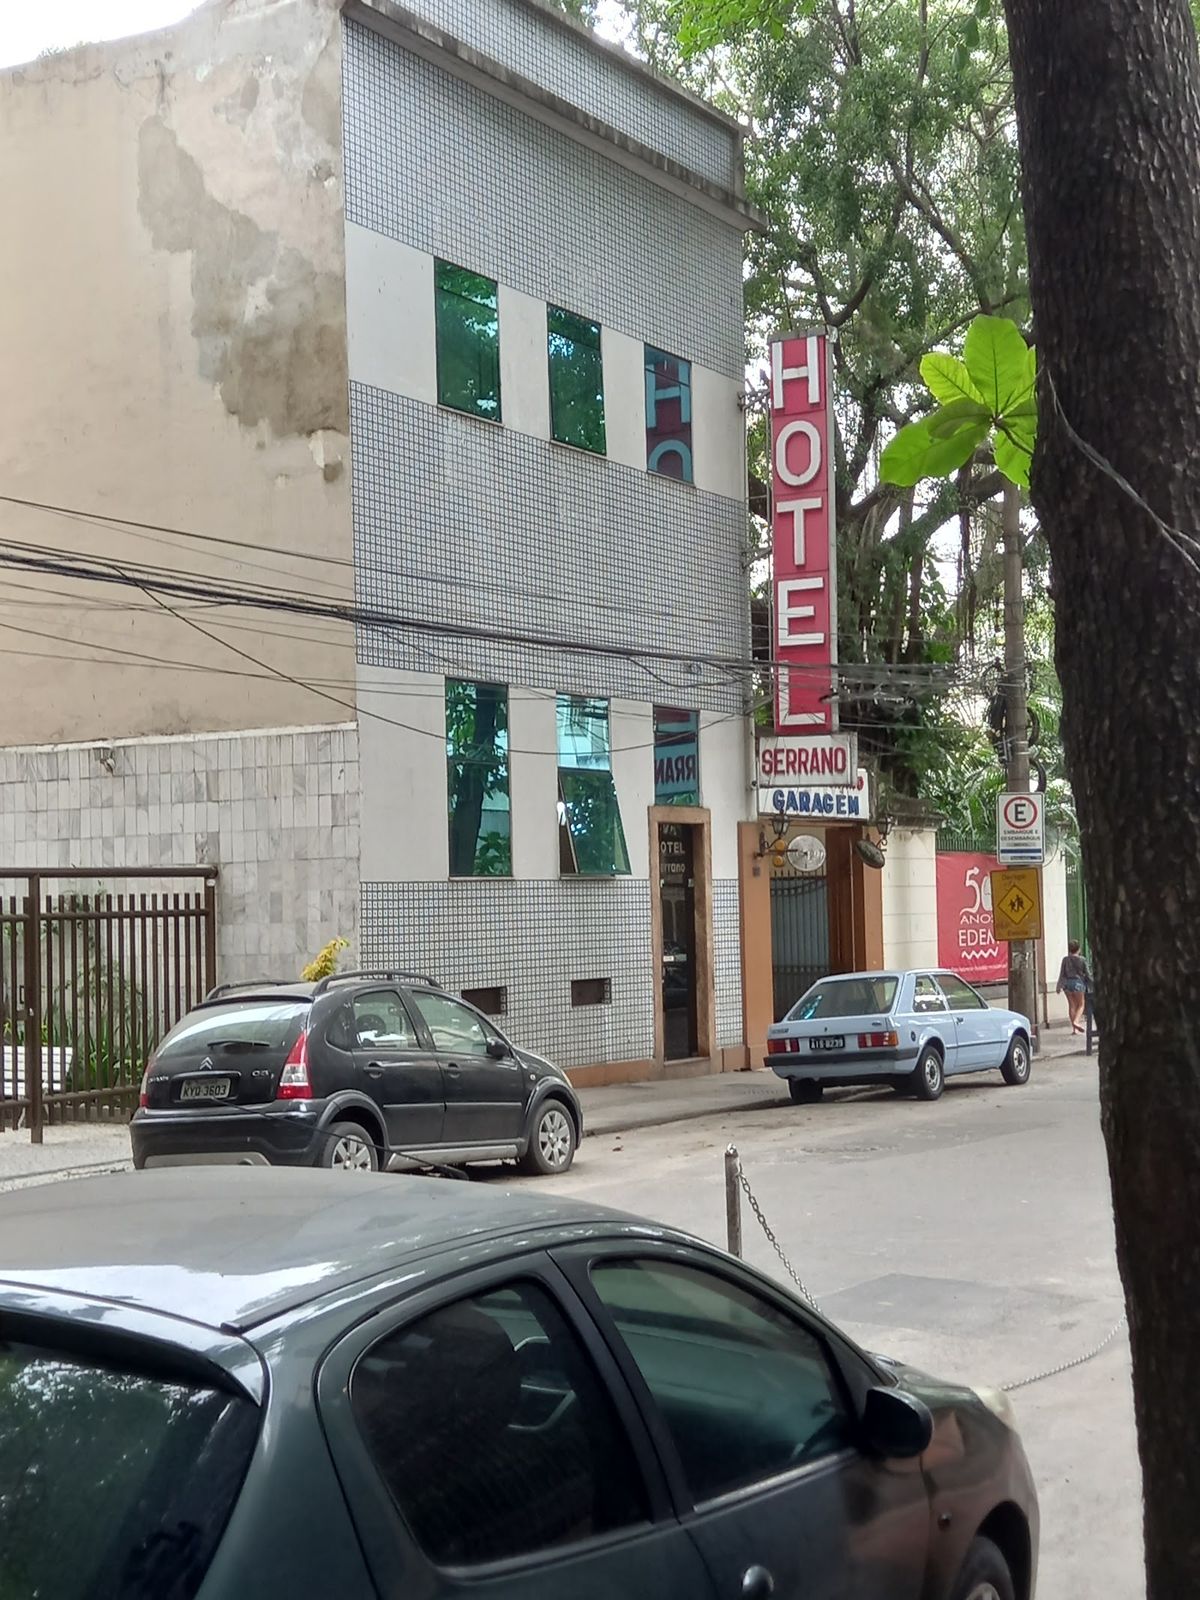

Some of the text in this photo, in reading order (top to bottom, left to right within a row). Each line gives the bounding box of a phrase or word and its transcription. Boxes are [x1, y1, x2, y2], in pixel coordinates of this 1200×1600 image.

[771, 336, 825, 727] HOTEL
[761, 747, 848, 777] SERRANO
[1014, 803, 1027, 822] E
